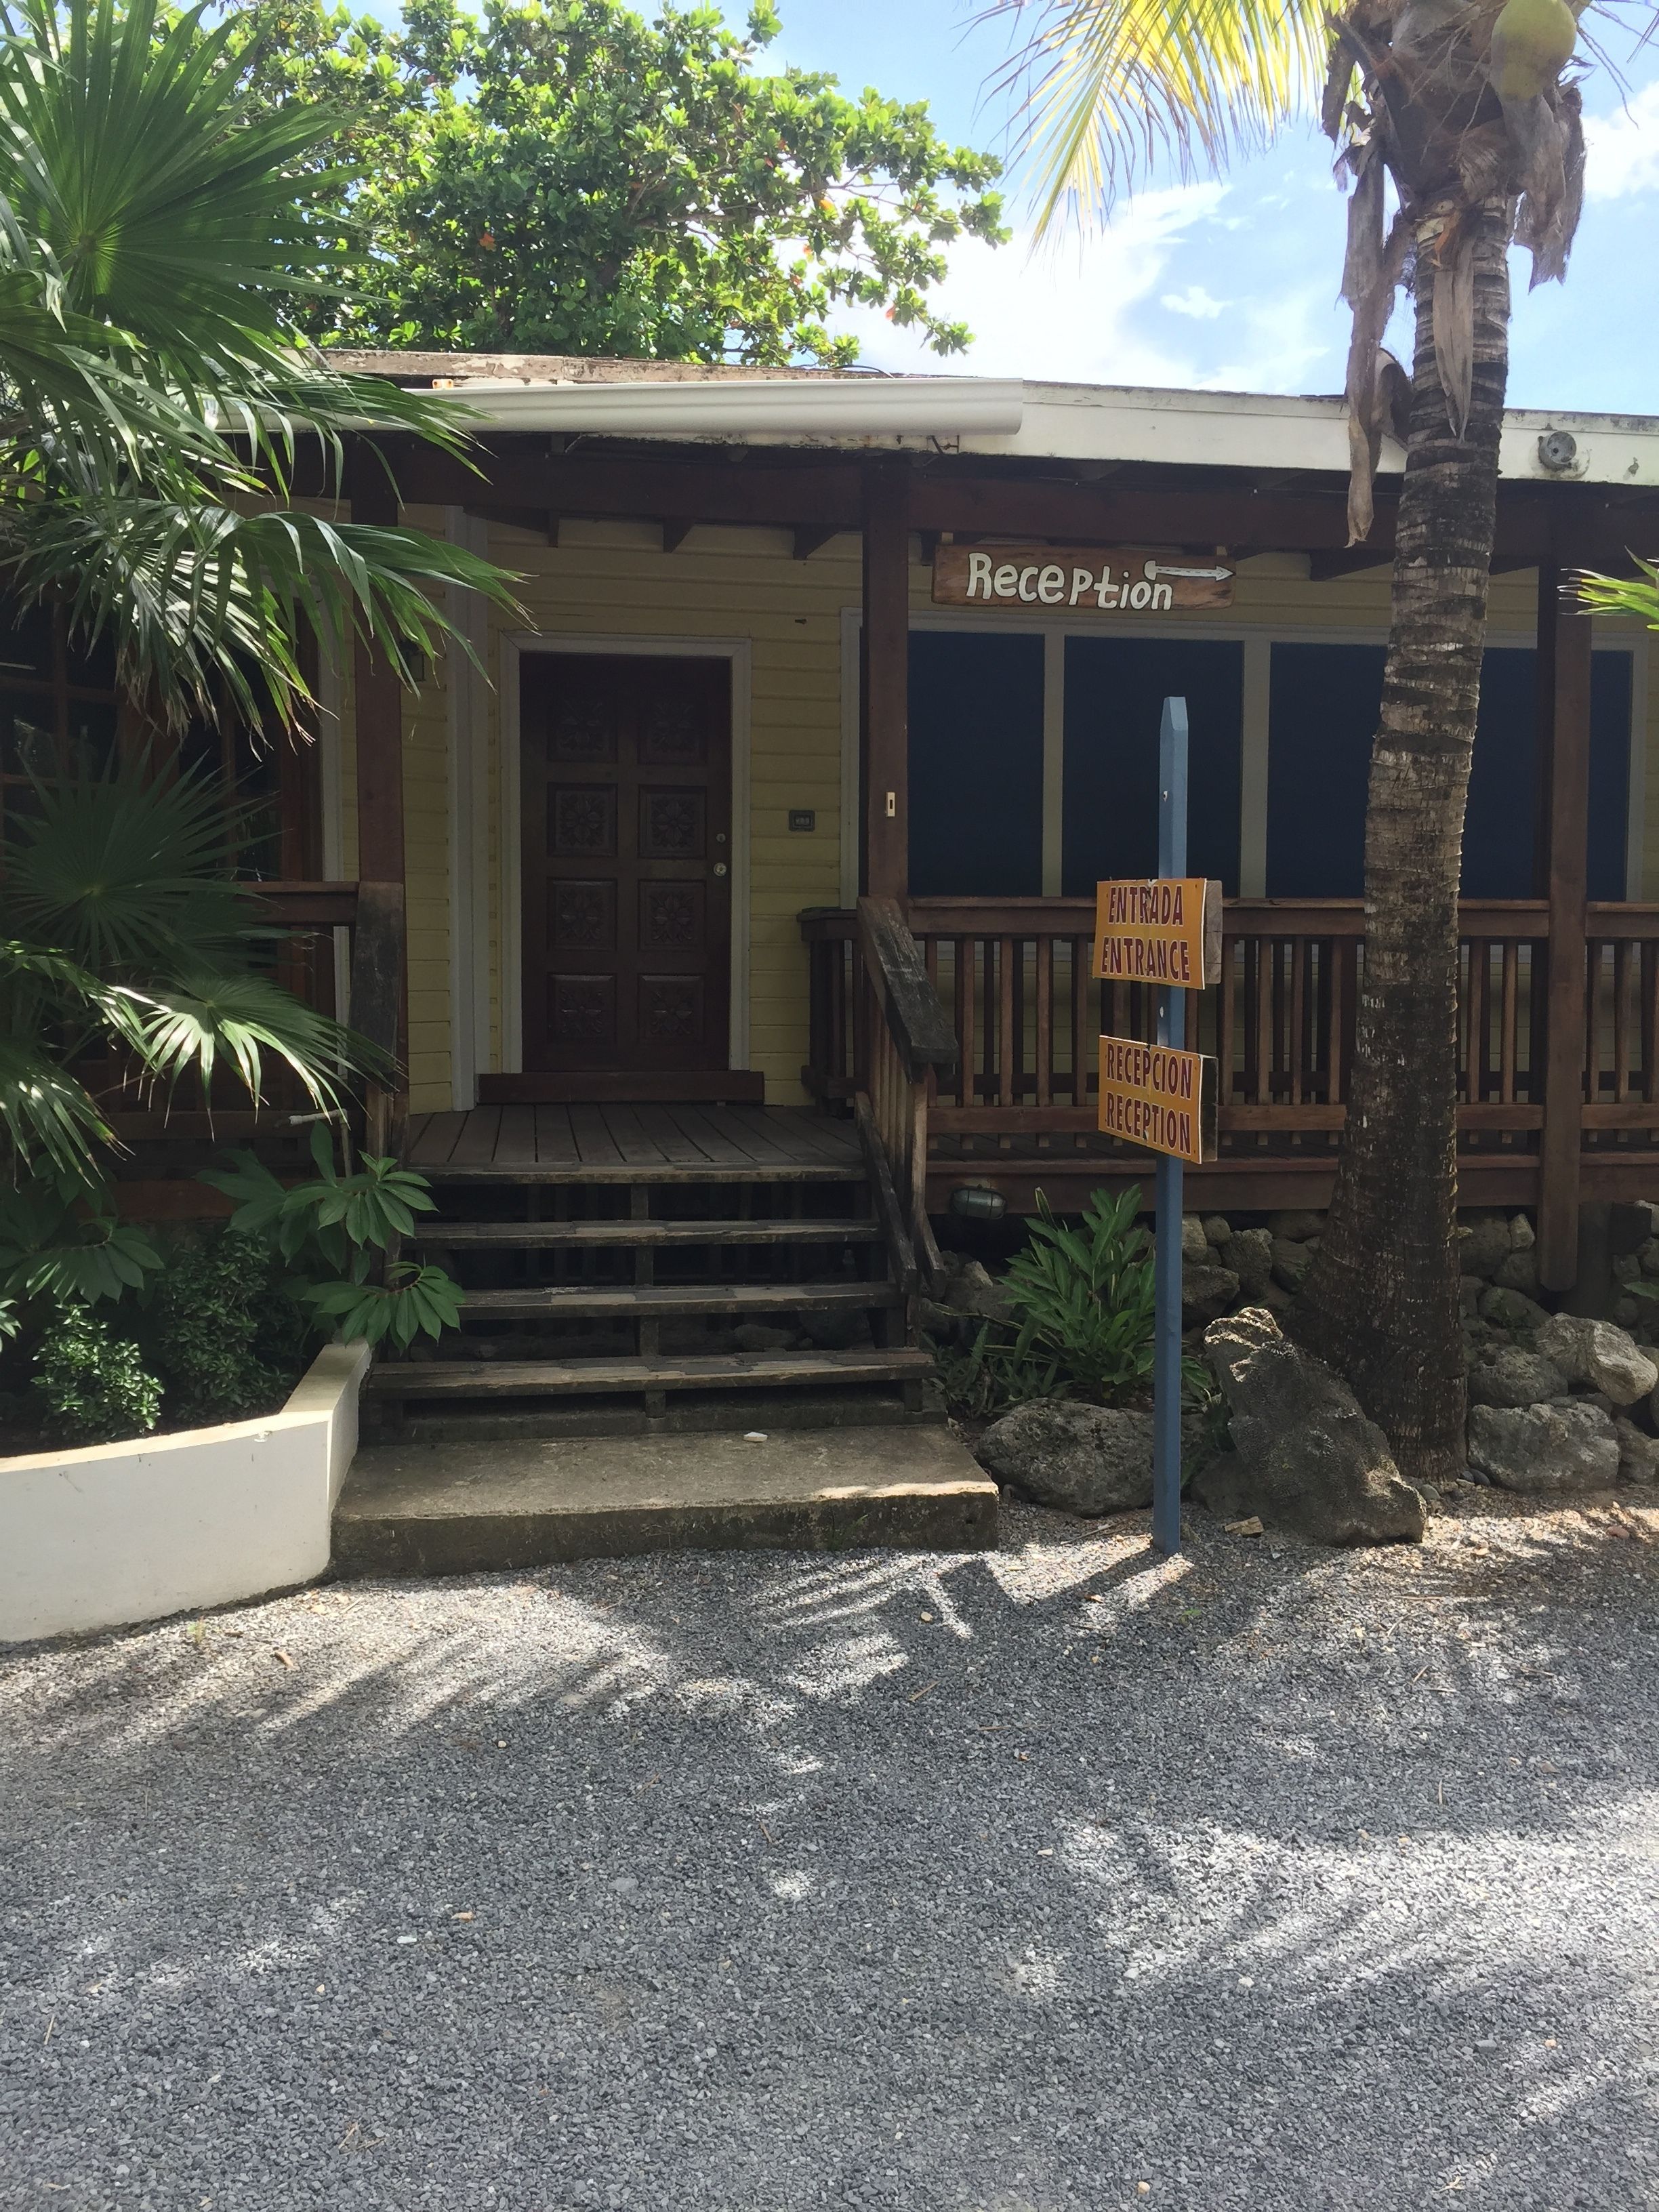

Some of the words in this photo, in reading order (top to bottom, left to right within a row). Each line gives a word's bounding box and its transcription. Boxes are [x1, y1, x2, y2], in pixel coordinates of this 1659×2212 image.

[966, 552, 1172, 610] Reception
[1107, 884, 1184, 927] ENTRADA
[1101, 936, 1191, 983] ENTRANCE
[1106, 1042, 1193, 1100] RECEPCION
[1106, 1091, 1191, 1155] RECEPTION
